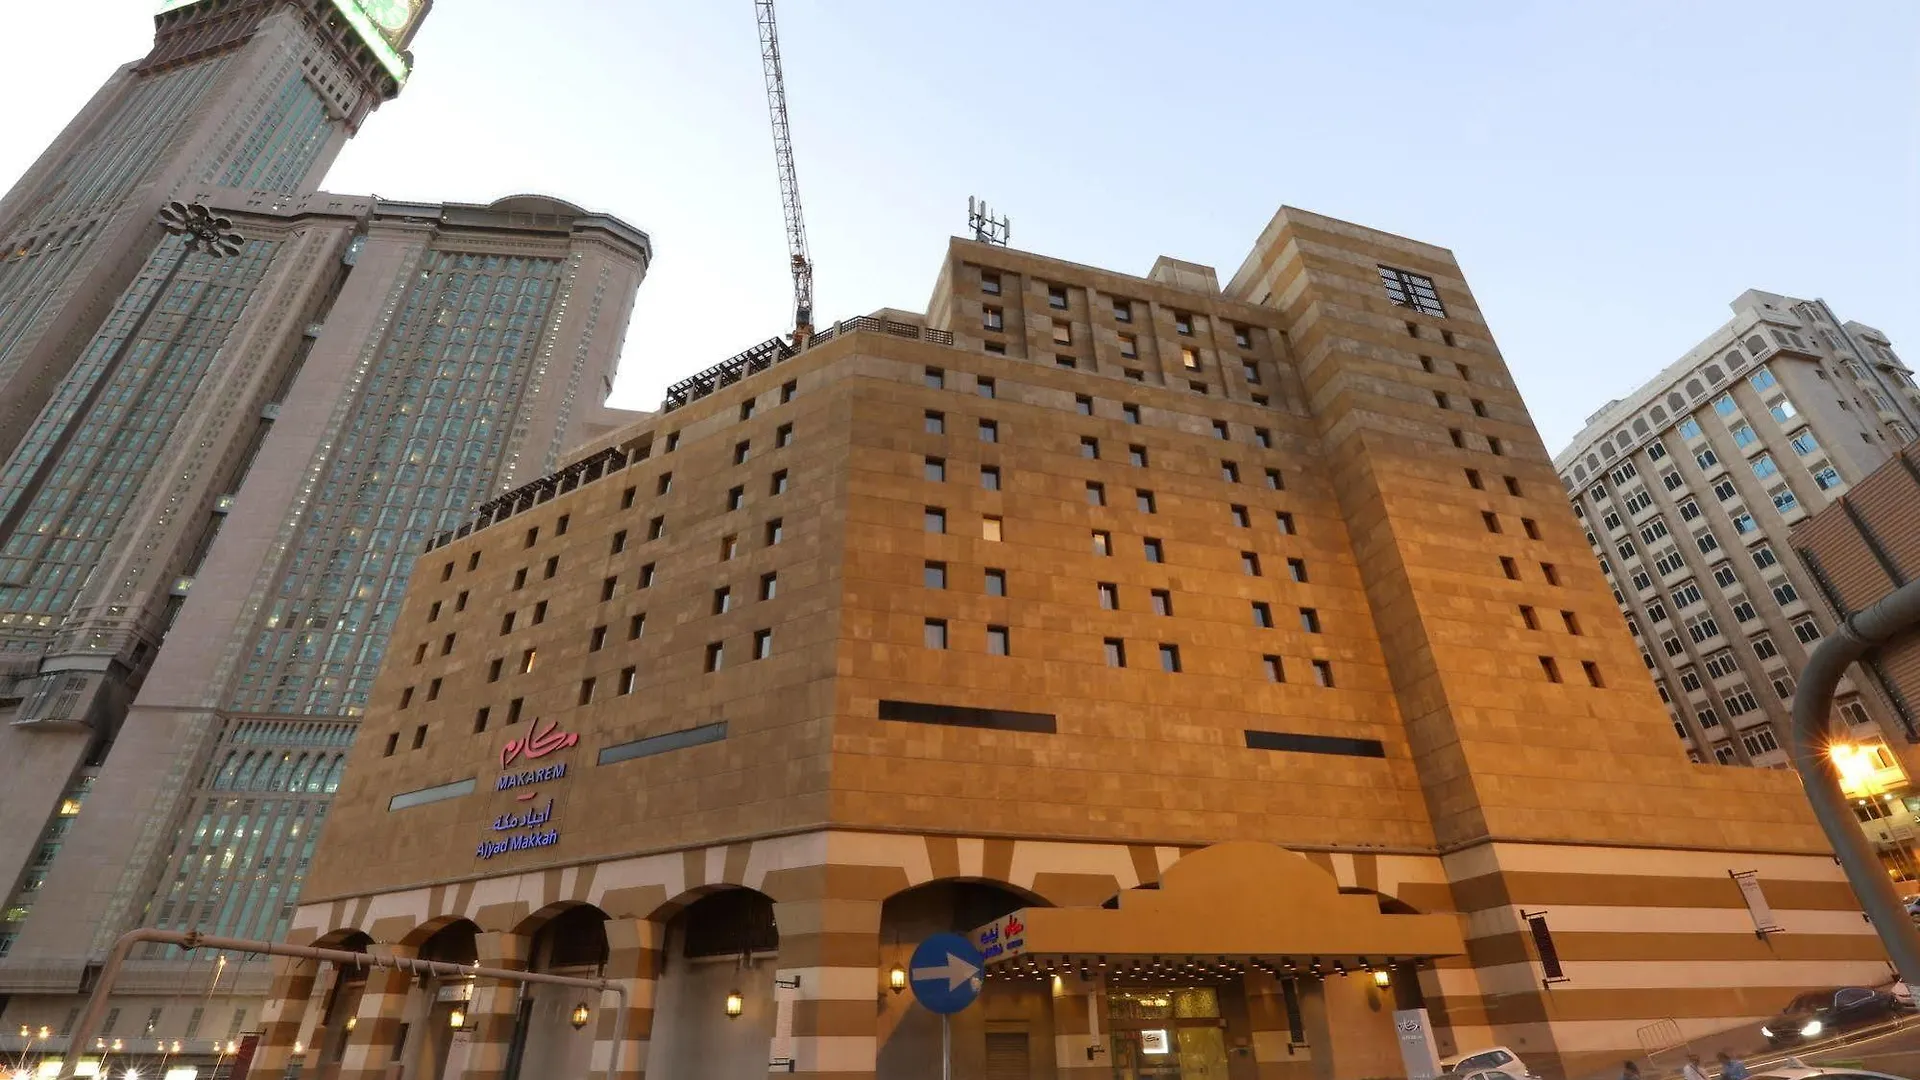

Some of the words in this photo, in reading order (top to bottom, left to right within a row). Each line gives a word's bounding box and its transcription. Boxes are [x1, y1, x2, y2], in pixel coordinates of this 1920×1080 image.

[500, 716, 579, 770] مكارم
[495, 763, 567, 791] MAKAREM
[476, 837, 511, 860] Ajyad
[511, 828, 558, 851] Makkah
